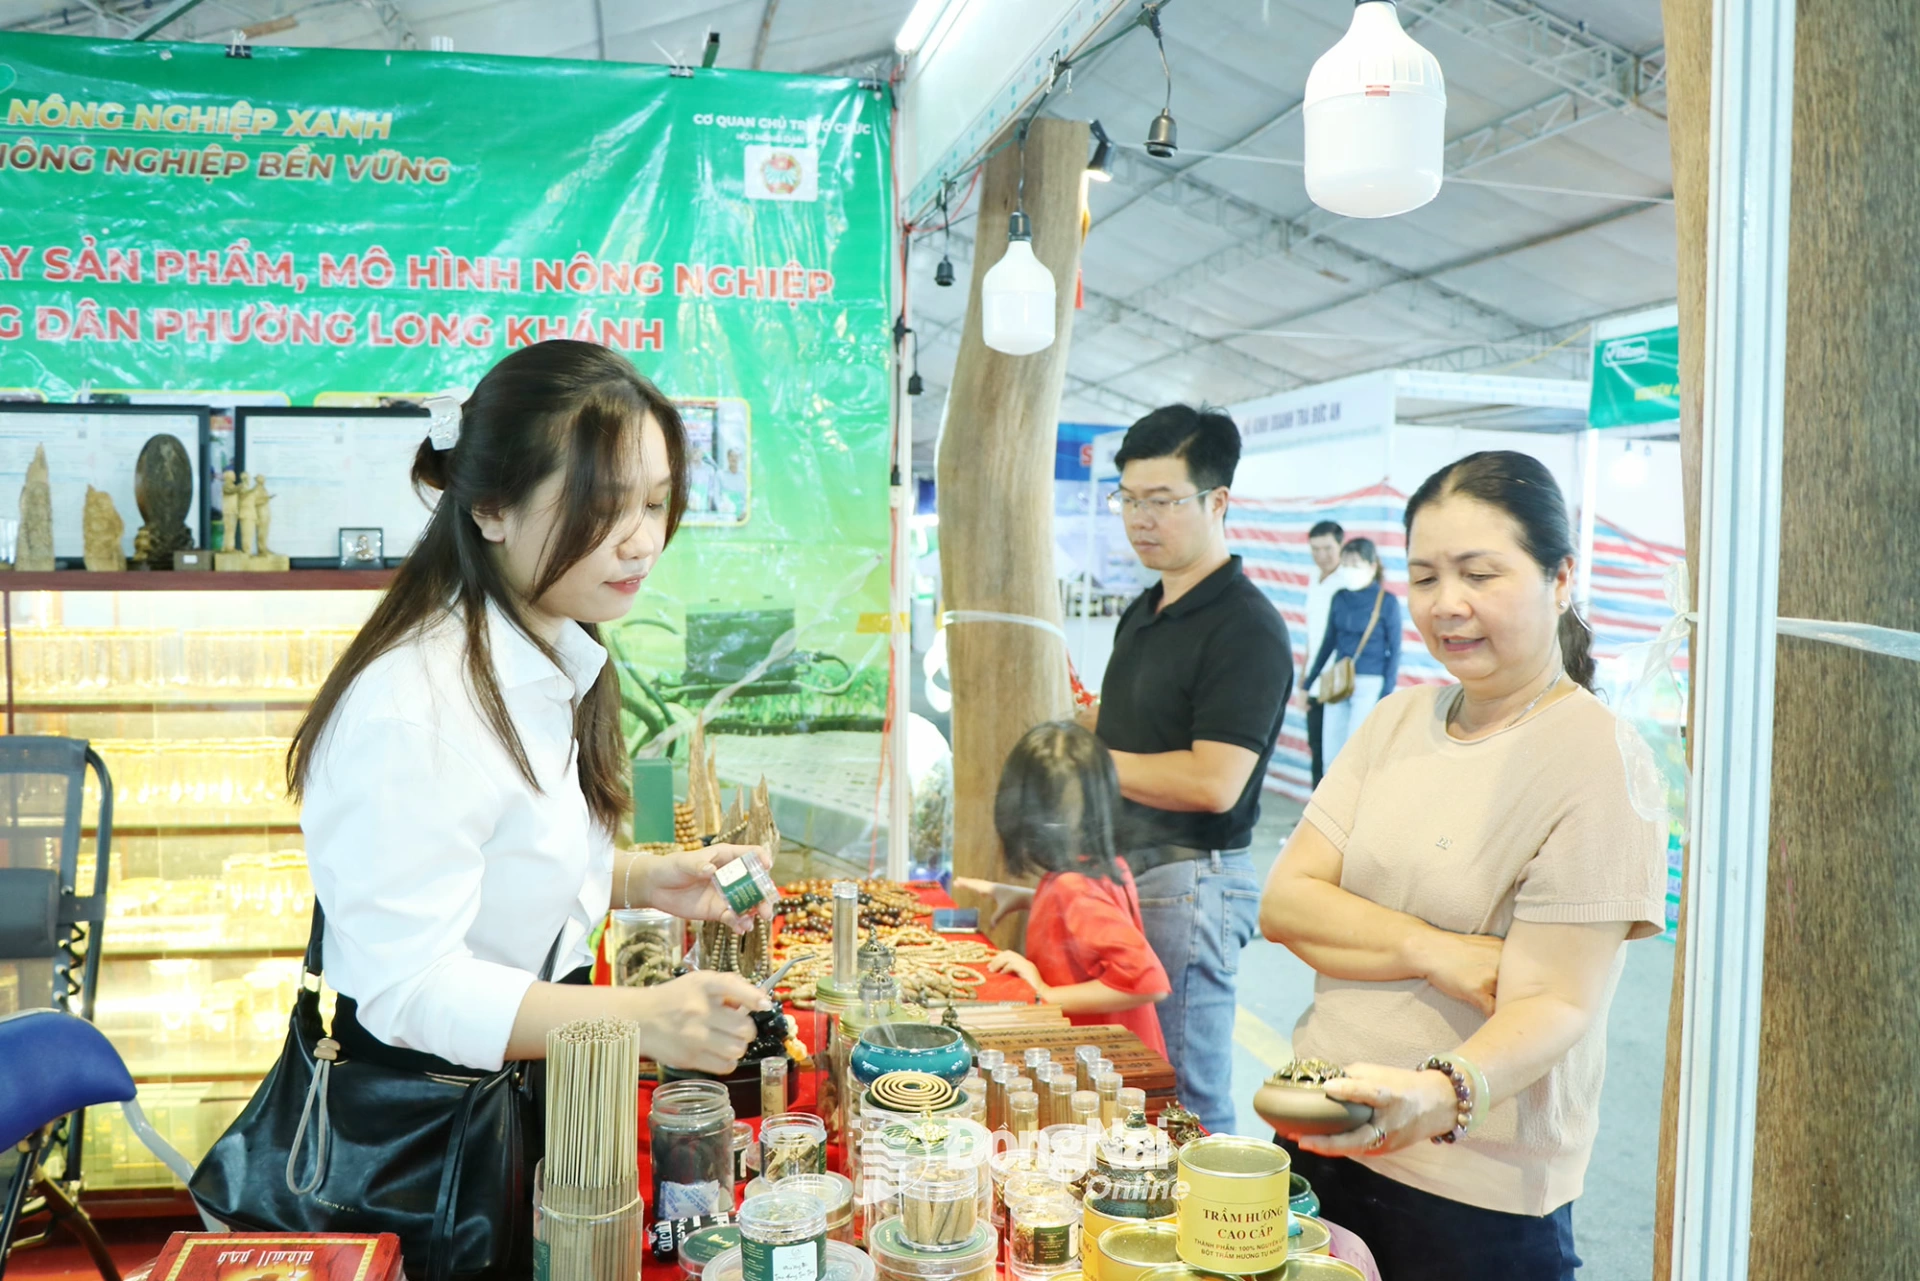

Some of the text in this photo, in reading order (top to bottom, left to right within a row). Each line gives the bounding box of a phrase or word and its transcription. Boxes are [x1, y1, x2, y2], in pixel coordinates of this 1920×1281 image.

[7, 93, 393, 141] NÔNG NGHIỆP XANH
[693, 113, 713, 125] CƠ
[716, 115, 755, 128] QUAN
[758, 115, 787, 130] CHỦ
[105, 144, 248, 183] NGHIỆP
[257, 142, 335, 181] BỀN
[344, 149, 451, 183] VỮNG
[42, 235, 142, 282] SẢN
[155, 238, 308, 293] PHẨM,
[319, 245, 396, 288] MÔ
[407, 247, 521, 291] HÌNH
[533, 251, 664, 296] NÔNG
[674, 261, 834, 308] NGHIỆP
[36, 297, 141, 341] DÂN
[154, 302, 356, 346] PHƯỜNG
[367, 312, 493, 348] LONG
[505, 308, 664, 351] KHÁNH
[1203, 1206, 1283, 1223] TRẦM HƯƠNG
[1217, 1228, 1246, 1241] CAO
[1249, 1223, 1273, 1240] CẤP
[216, 1249, 255, 1267] فحم
